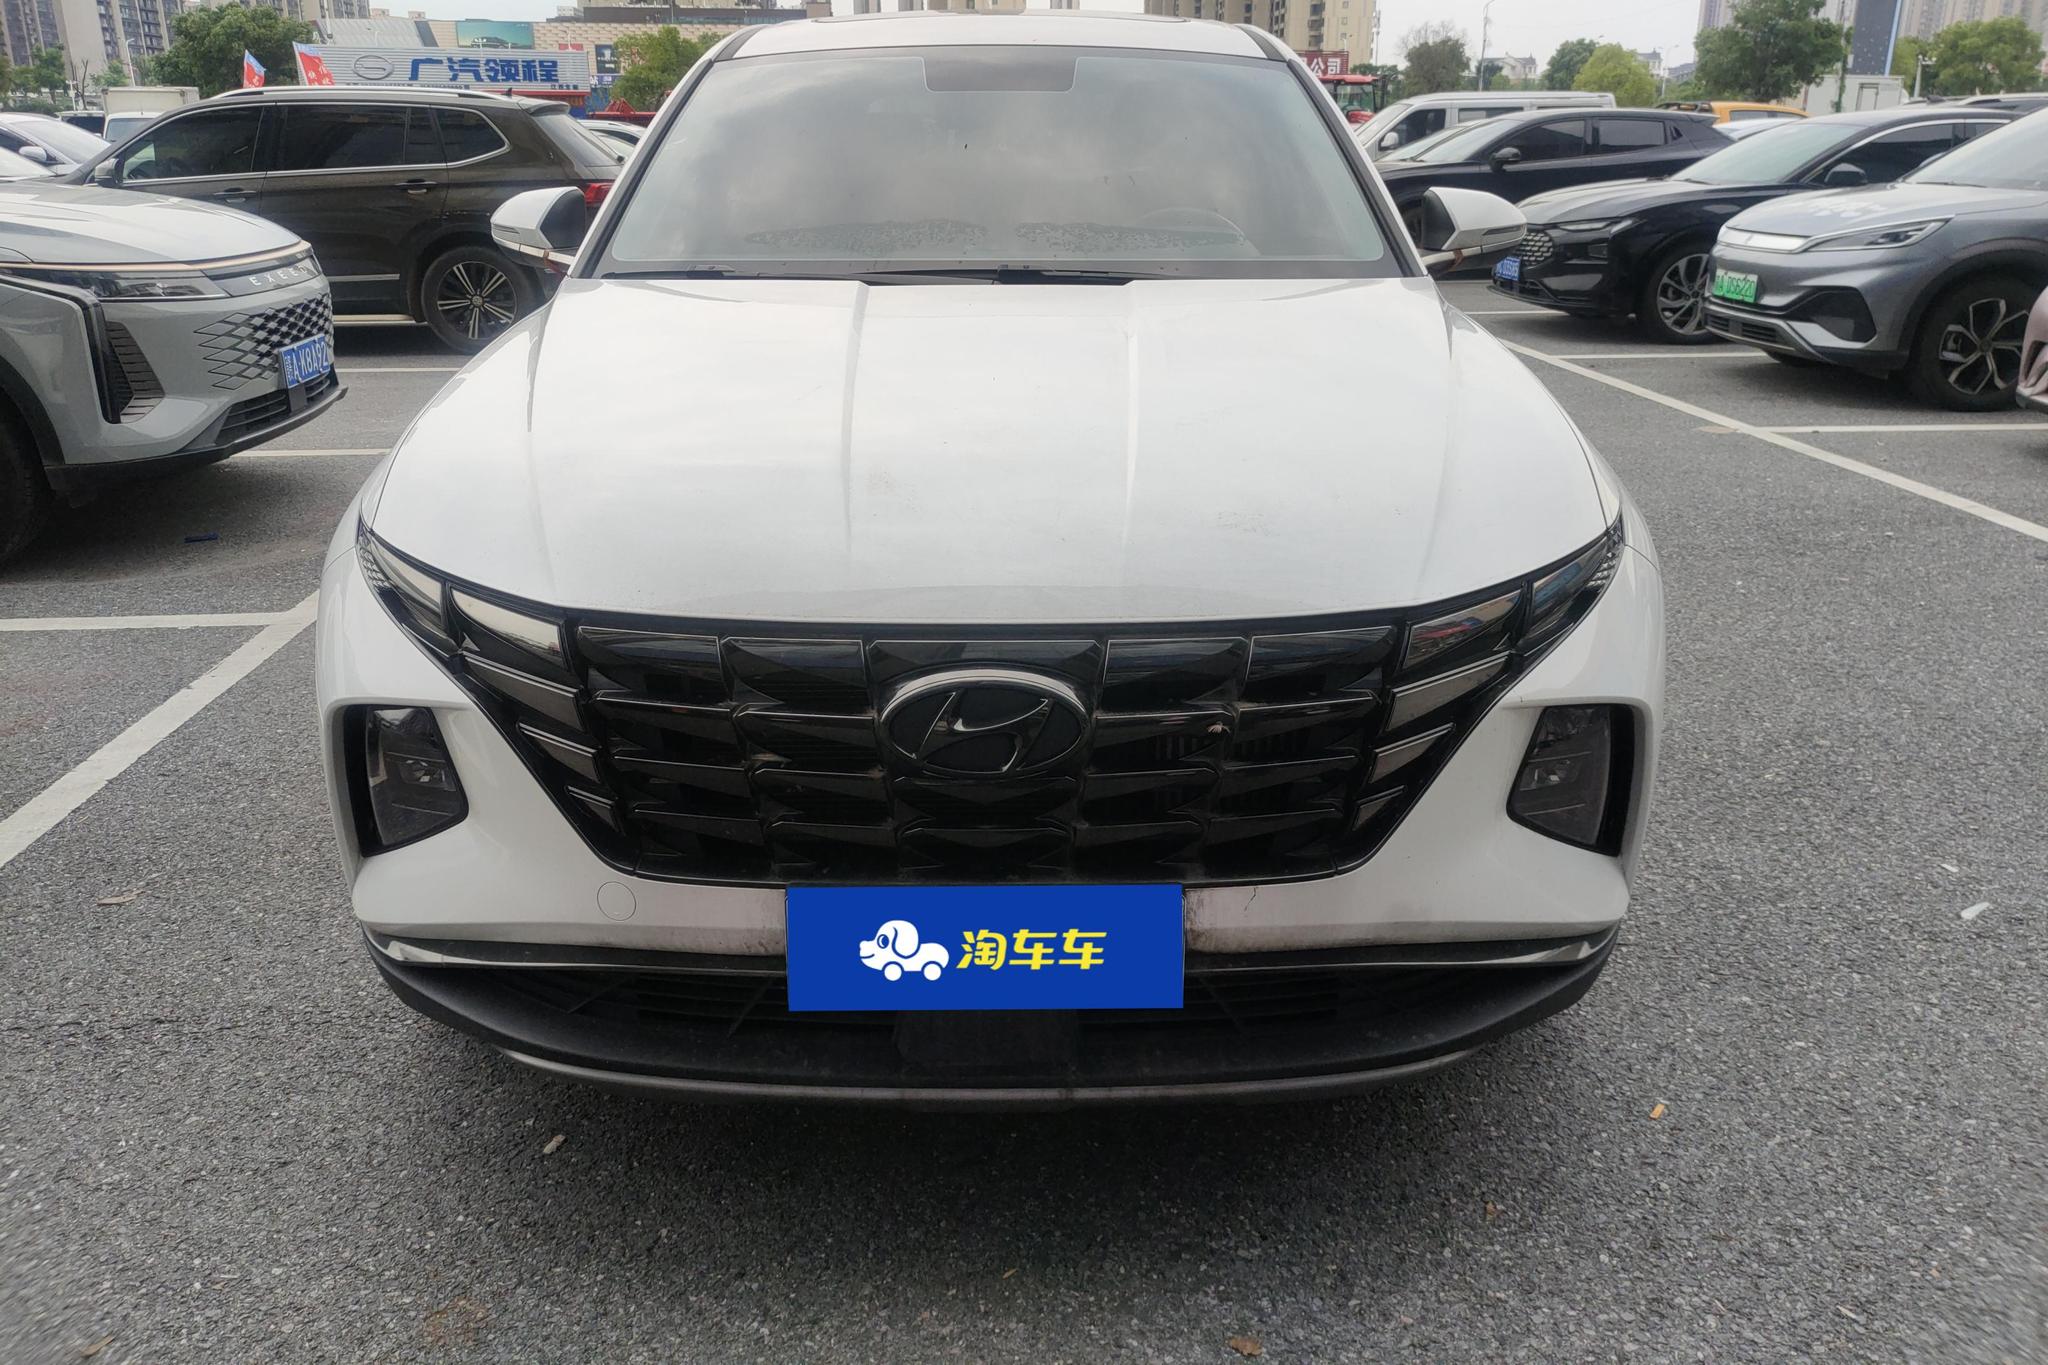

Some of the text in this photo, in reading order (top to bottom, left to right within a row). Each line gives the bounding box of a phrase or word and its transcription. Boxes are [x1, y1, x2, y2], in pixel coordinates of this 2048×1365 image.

[408, 57, 559, 83] 广汽领程
[248, 265, 308, 287] EXEED
